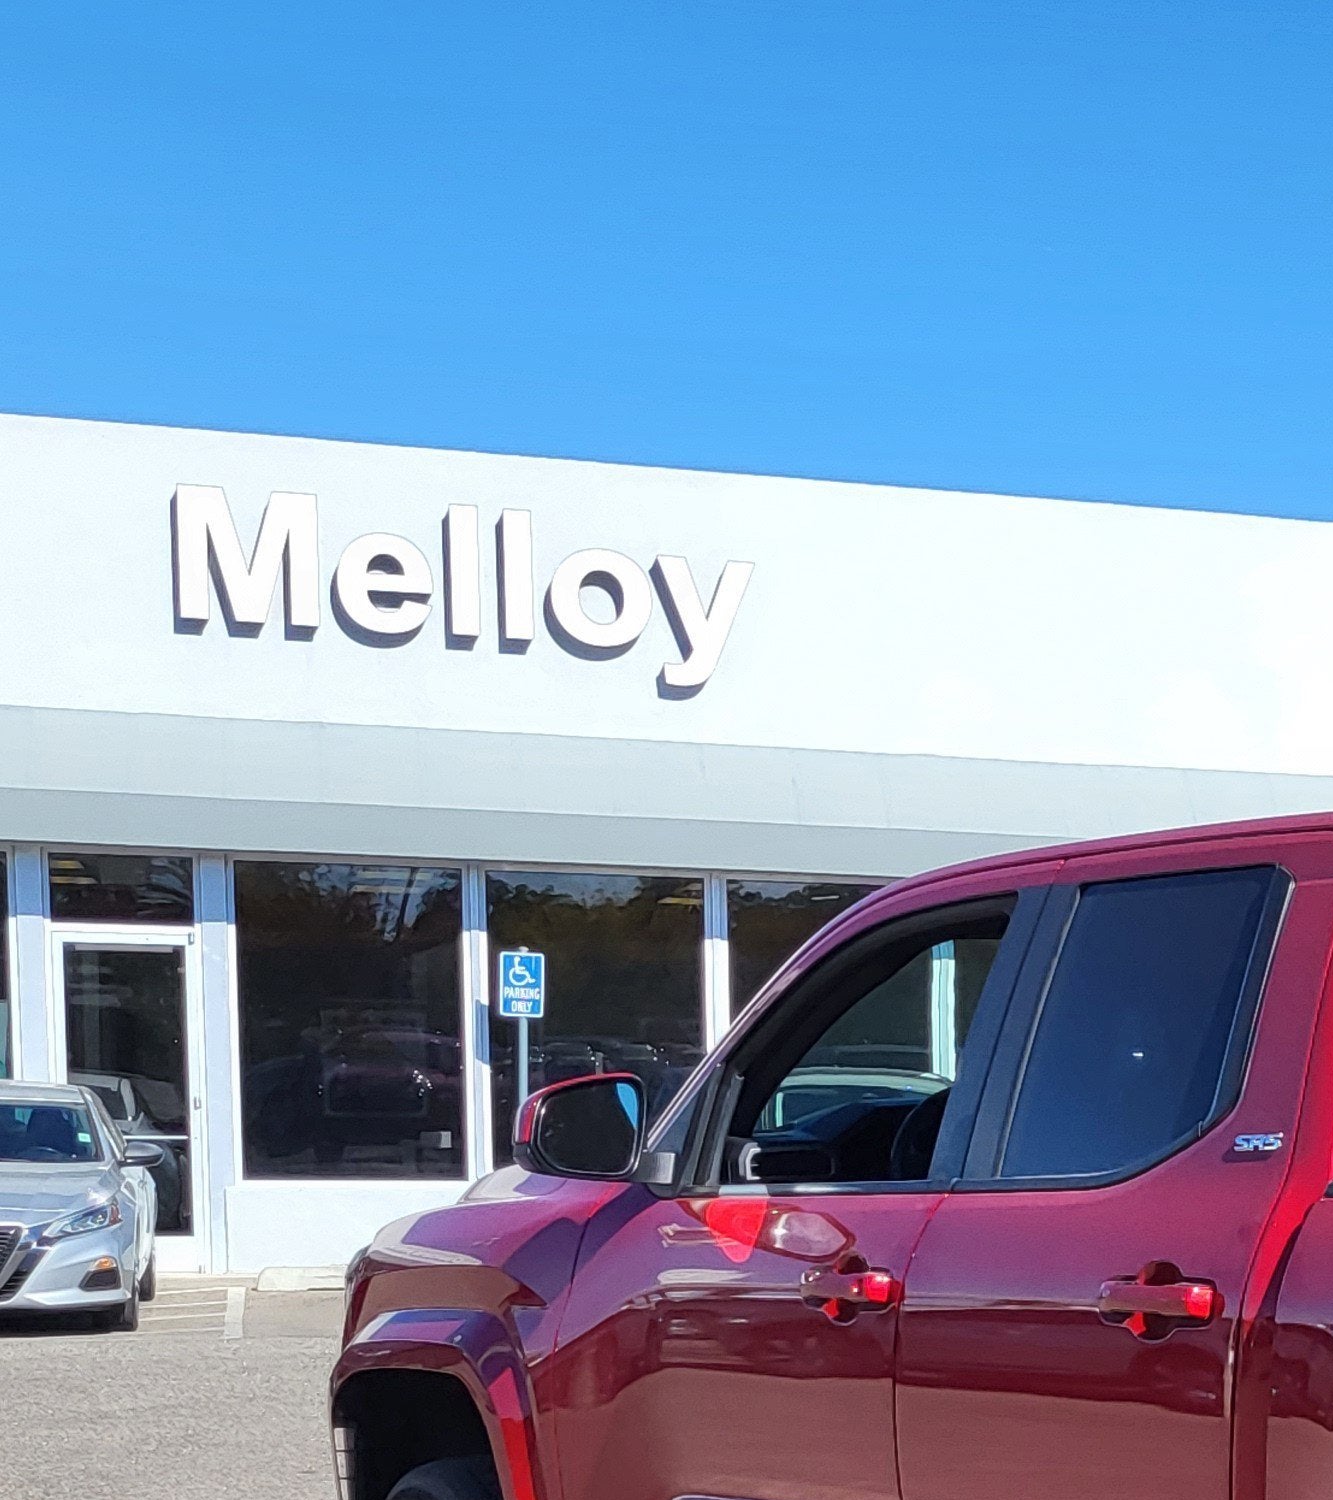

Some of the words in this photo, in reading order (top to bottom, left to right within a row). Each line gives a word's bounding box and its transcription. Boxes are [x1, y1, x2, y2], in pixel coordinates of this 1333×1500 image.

[170, 482, 756, 701] Melloy
[503, 986, 541, 1000] PARKING
[511, 1000, 533, 1013] ONLY
[1233, 1132, 1284, 1152] SR5
